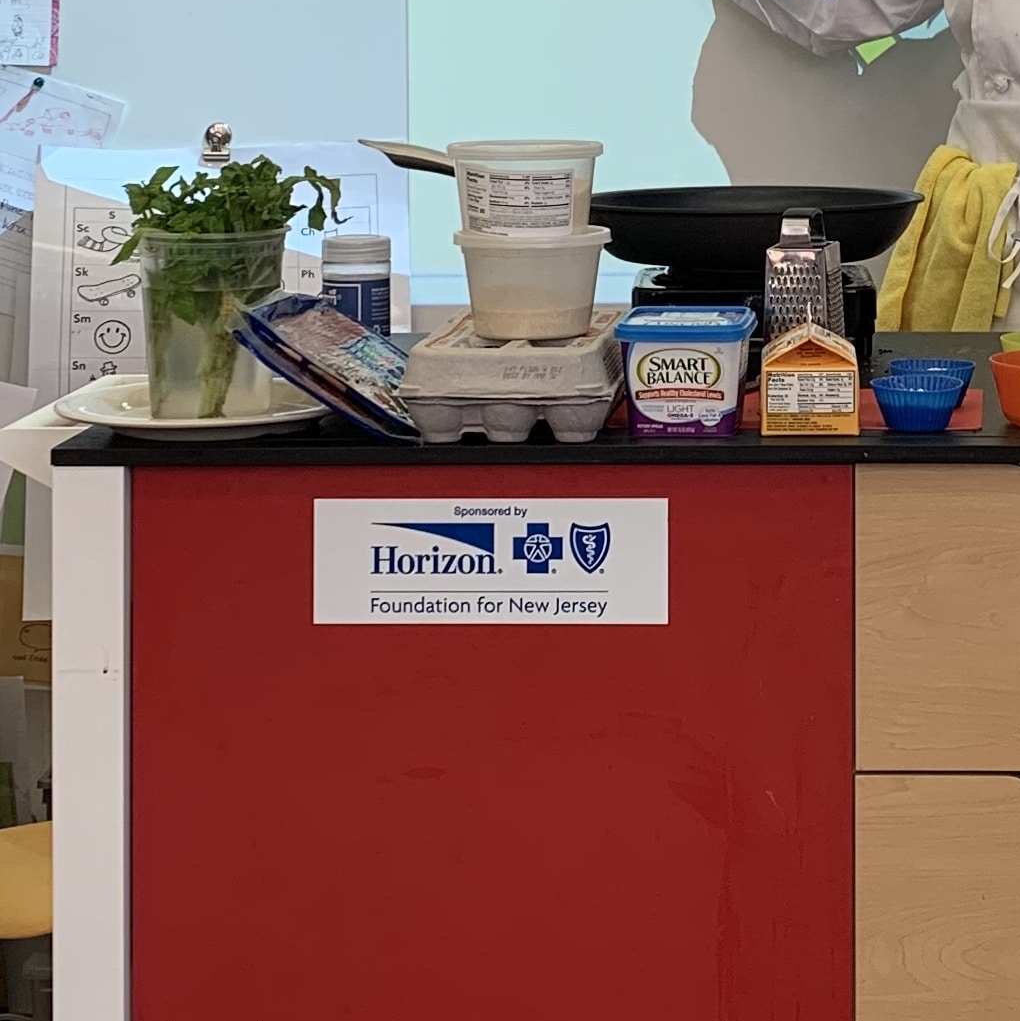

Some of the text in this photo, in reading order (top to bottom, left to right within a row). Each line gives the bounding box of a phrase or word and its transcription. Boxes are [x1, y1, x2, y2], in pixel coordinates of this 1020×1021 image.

[109, 211, 116, 219] S
[76, 224, 89, 233] Sc
[301, 227, 315, 236] Ch
[75, 267, 89, 277] Sk
[301, 270, 315, 278] Ph
[73, 314, 91, 323] Sm
[72, 360, 86, 370] Sn
[648, 357, 709, 372] SMART
[647, 371, 713, 385] BALANCE
[667, 404, 694, 413] LIGHT
[453, 506, 528, 517] Sponsored by
[371, 546, 496, 574] Horizon
[371, 597, 608, 618] Foundation for New Jersey
